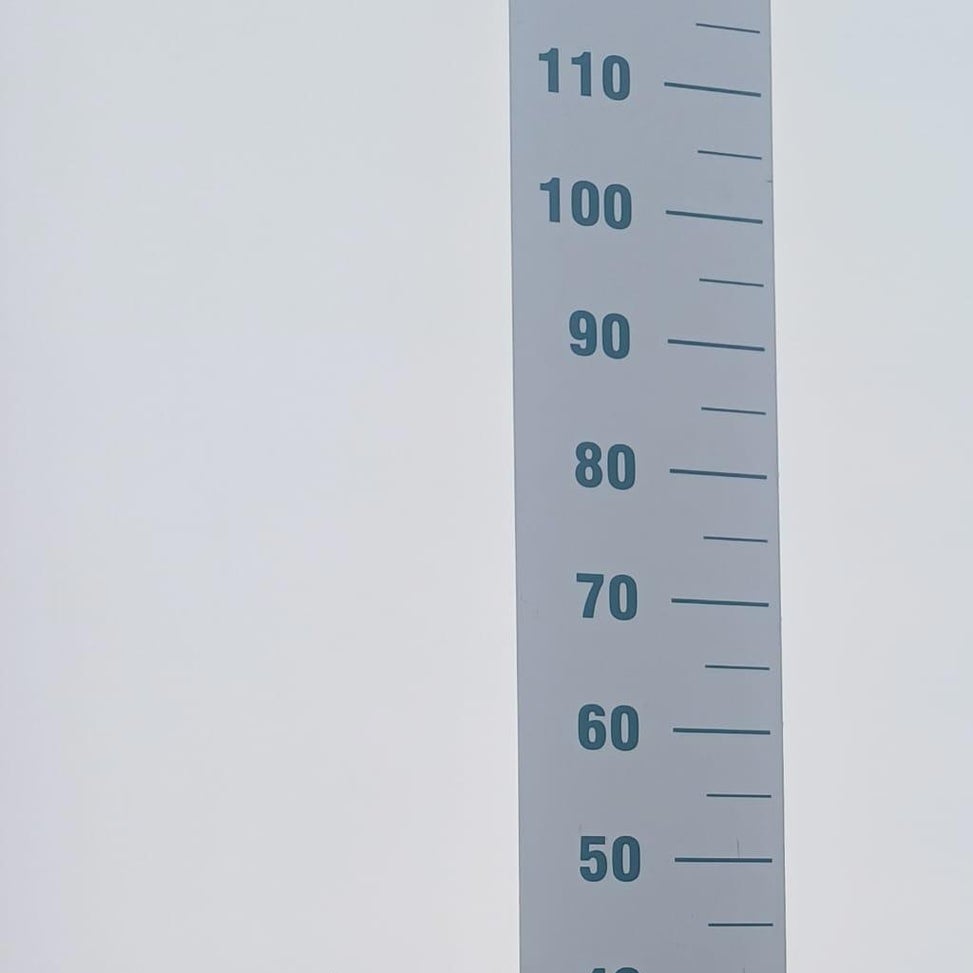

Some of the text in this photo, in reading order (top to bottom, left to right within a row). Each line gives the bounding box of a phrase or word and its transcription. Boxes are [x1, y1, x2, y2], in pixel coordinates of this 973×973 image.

[539, 48, 630, 100] 110
[540, 178, 631, 229] 100
[569, 310, 630, 359] 90
[575, 442, 635, 490] 80
[577, 573, 637, 620] 70
[578, 704, 639, 751] 60
[580, 836, 640, 882] 50
